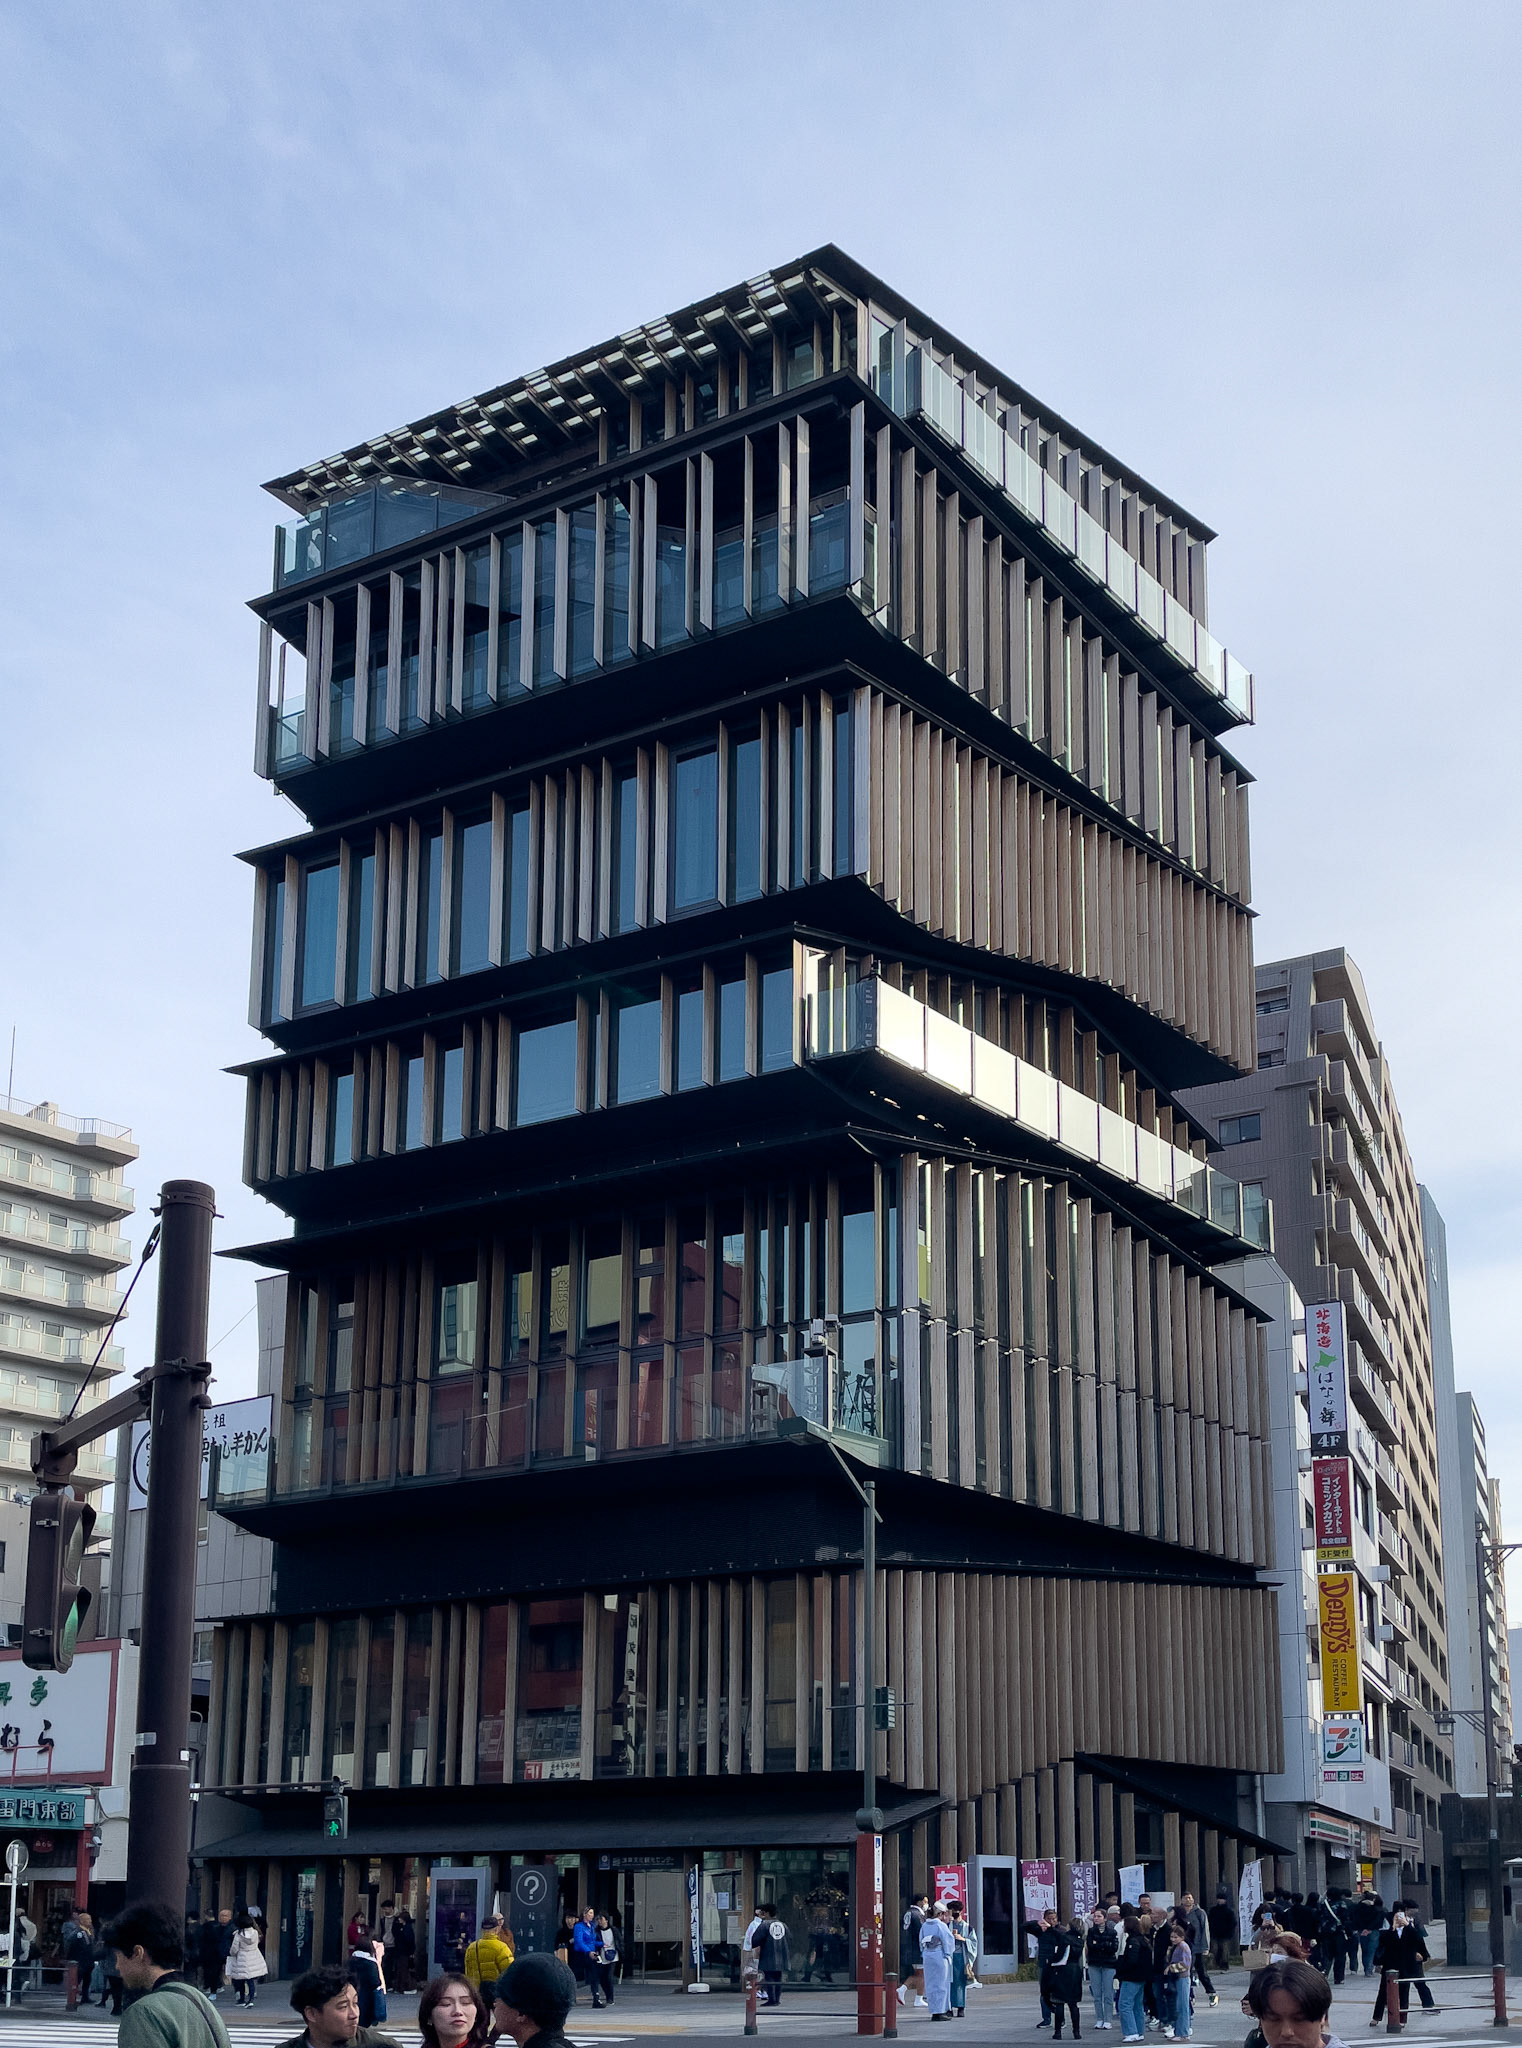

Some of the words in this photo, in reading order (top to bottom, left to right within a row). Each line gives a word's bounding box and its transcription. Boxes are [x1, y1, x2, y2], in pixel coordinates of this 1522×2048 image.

[1315, 1307, 1331, 1348] 北海道
[1317, 1433, 1341, 1448] 4F
[1321, 1477, 1334, 1534] コミックカフェ
[1320, 1549, 1349, 1558] 3F受付
[1320, 1578, 1354, 1654] Denny's
[1332, 1658, 1341, 1707] RESTAURANT
[1340, 1658, 1348, 1687] COFFEE
[1324, 1772, 1336, 1780] ATM
